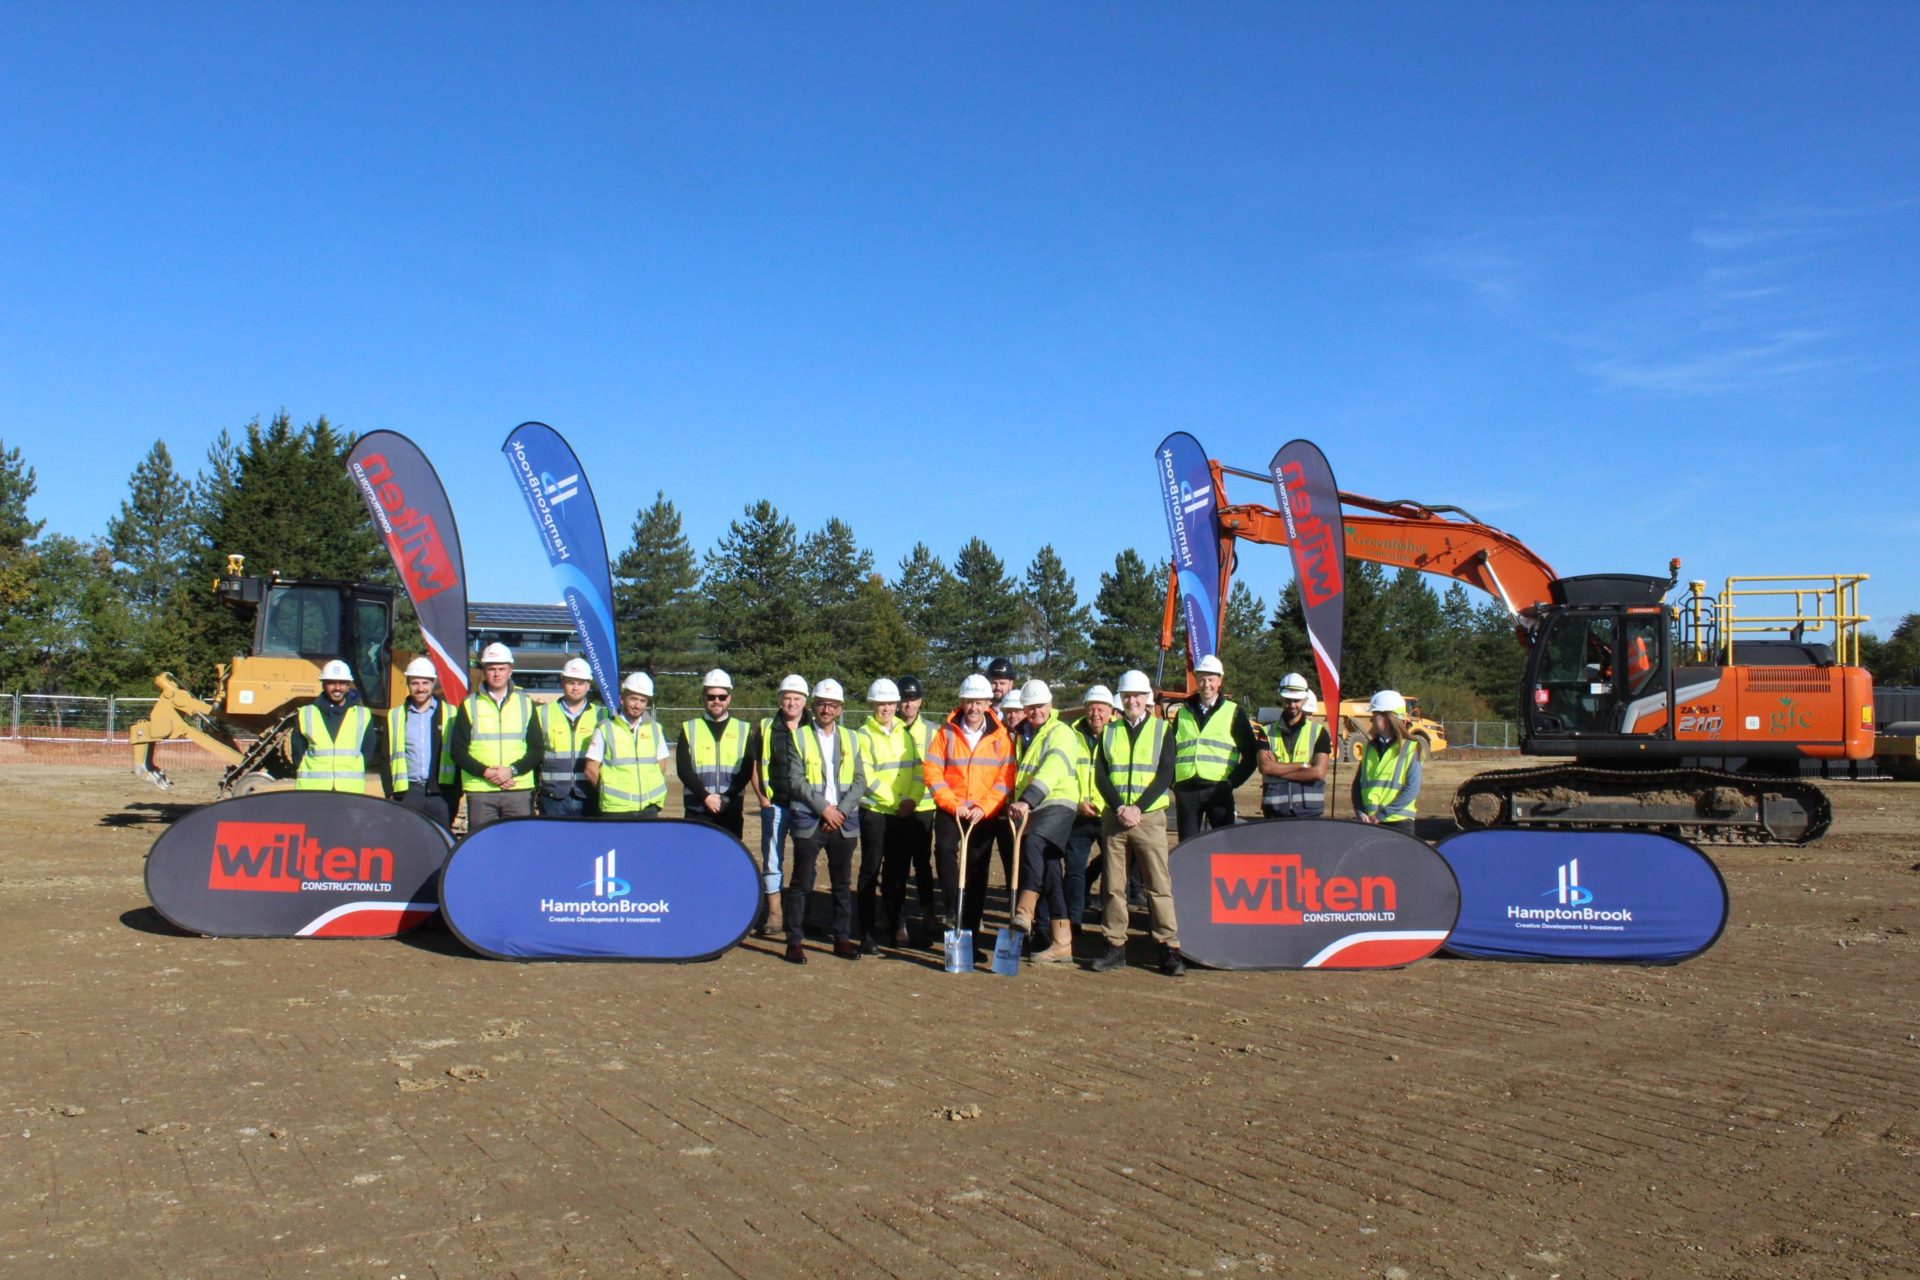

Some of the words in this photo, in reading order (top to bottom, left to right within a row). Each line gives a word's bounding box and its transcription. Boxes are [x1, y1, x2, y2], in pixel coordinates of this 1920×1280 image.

[1677, 715, 1724, 732] 210
[1769, 702, 1814, 735] gfc
[216, 834, 395, 881] wilten
[301, 881, 374, 892] CONSTRUCTION
[374, 882, 392, 893] LTD
[1213, 866, 1397, 912] wilten
[541, 898, 670, 915] HamptonBrook
[1507, 905, 1633, 922] HamptonBrook
[548, 915, 576, 923] Creative
[576, 916, 619, 924] Development
[1303, 912, 1377, 923] CONSTRUCTION
[1377, 912, 1396, 922] LTD
[1541, 923, 1583, 931] Development
